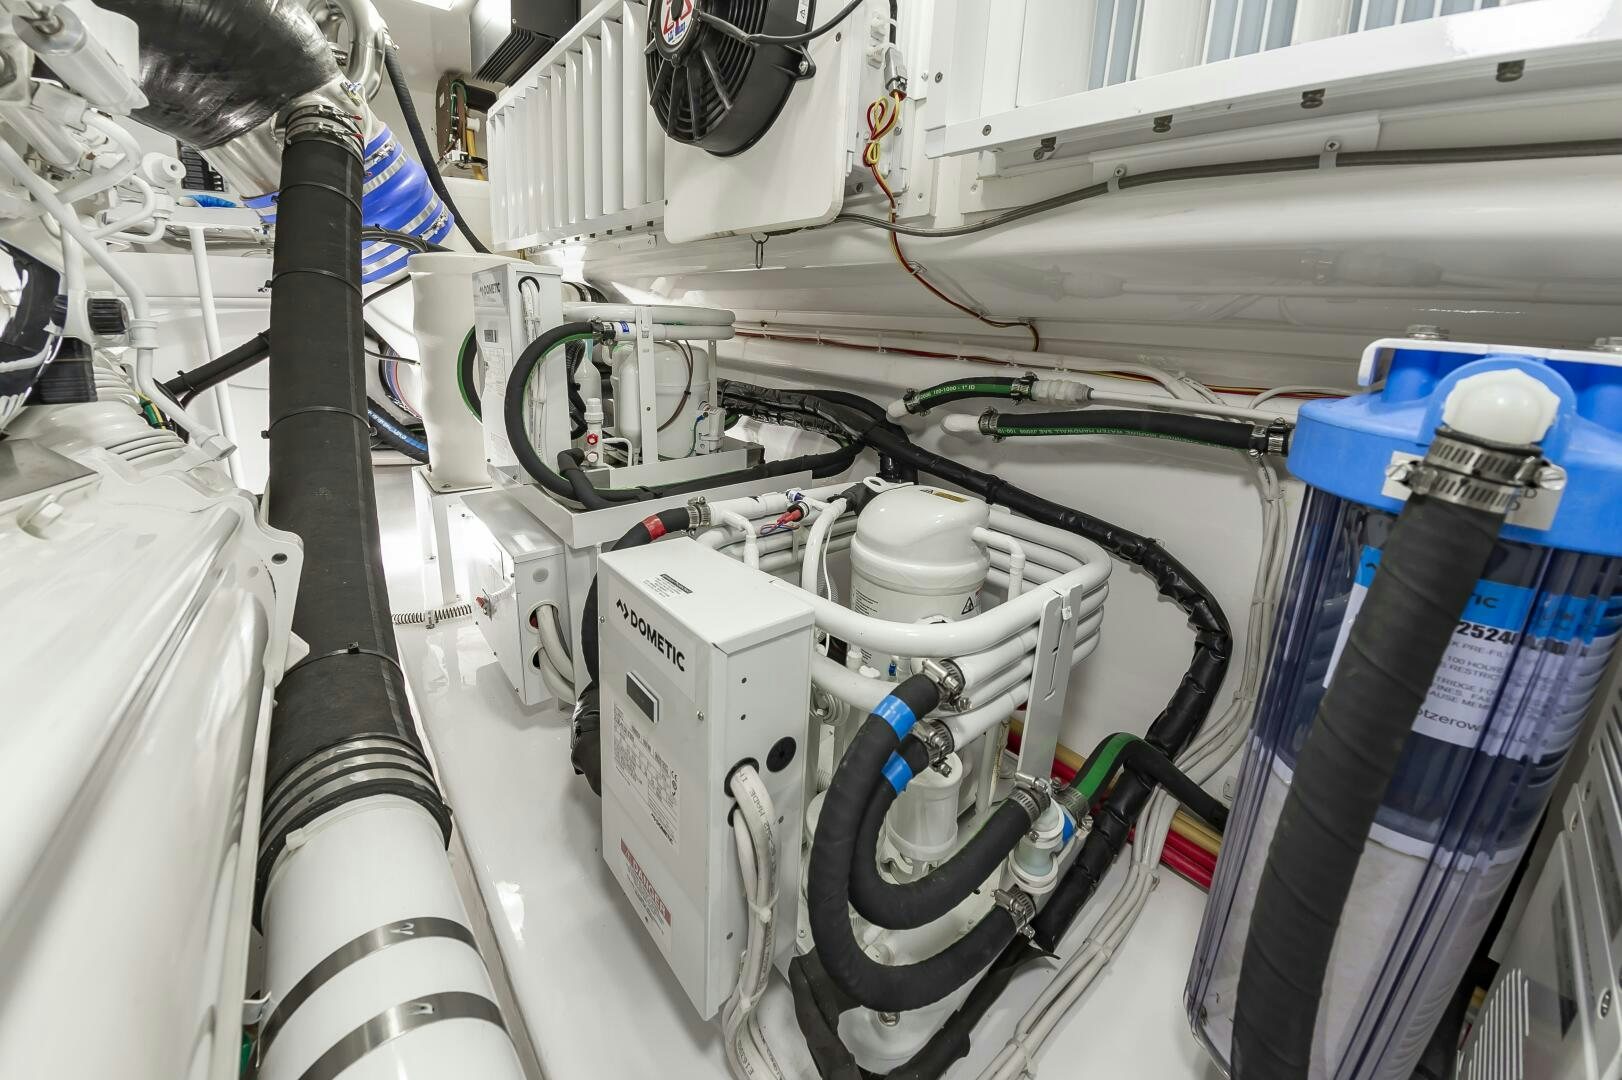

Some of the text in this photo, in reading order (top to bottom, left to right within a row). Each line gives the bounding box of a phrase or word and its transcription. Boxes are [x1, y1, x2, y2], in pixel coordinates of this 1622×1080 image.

[630, 608, 686, 673] DOMETIC
[1447, 655, 1465, 666] 100
[749, 789, 766, 817] MADE
[633, 862, 667, 918] DANGER
